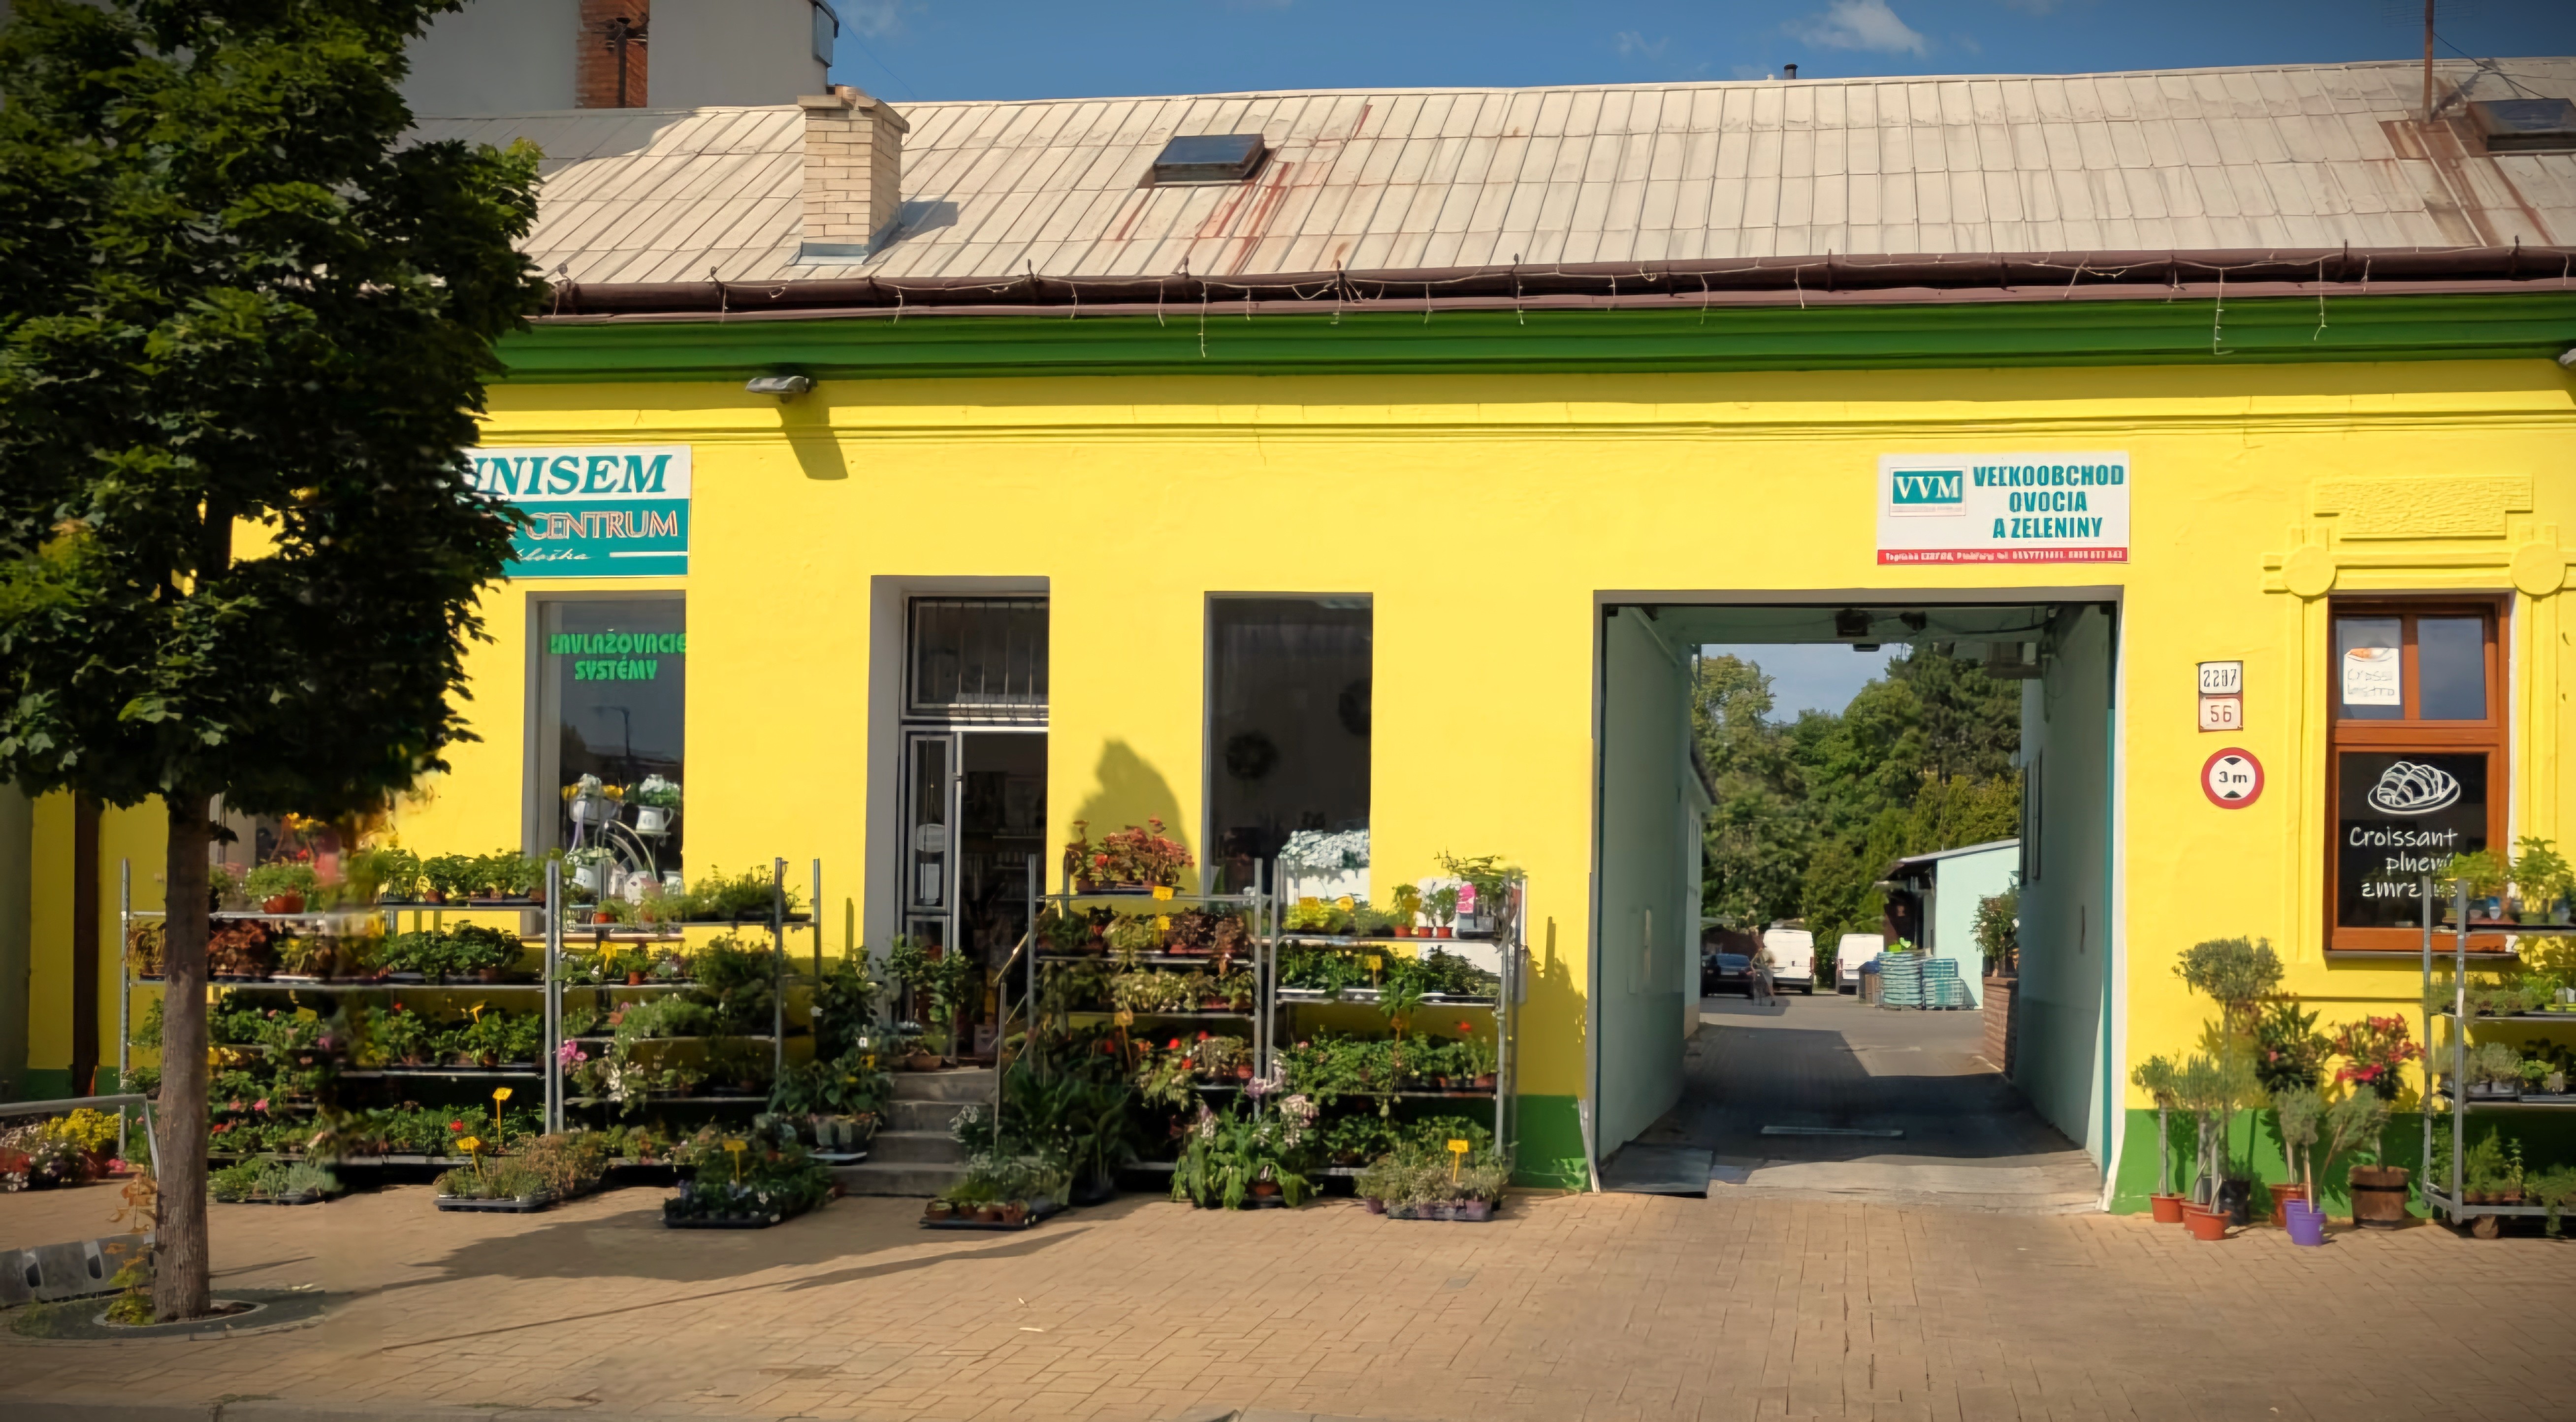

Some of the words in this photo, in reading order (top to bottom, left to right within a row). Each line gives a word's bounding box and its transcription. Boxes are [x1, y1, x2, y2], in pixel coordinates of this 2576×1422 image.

[1973, 464, 2124, 486] VEĽKOOBCHOD
[1896, 476, 1961, 499] VVM
[2009, 491, 2088, 512] OVOCIA
[525, 510, 678, 541] CENTRUM
[1993, 518, 2006, 538] A
[2011, 517, 2103, 538] ZELENINY
[575, 654, 658, 680] SYSTÉMY
[2210, 705, 2232, 722] 56
[2350, 826, 2458, 847] Croissant
